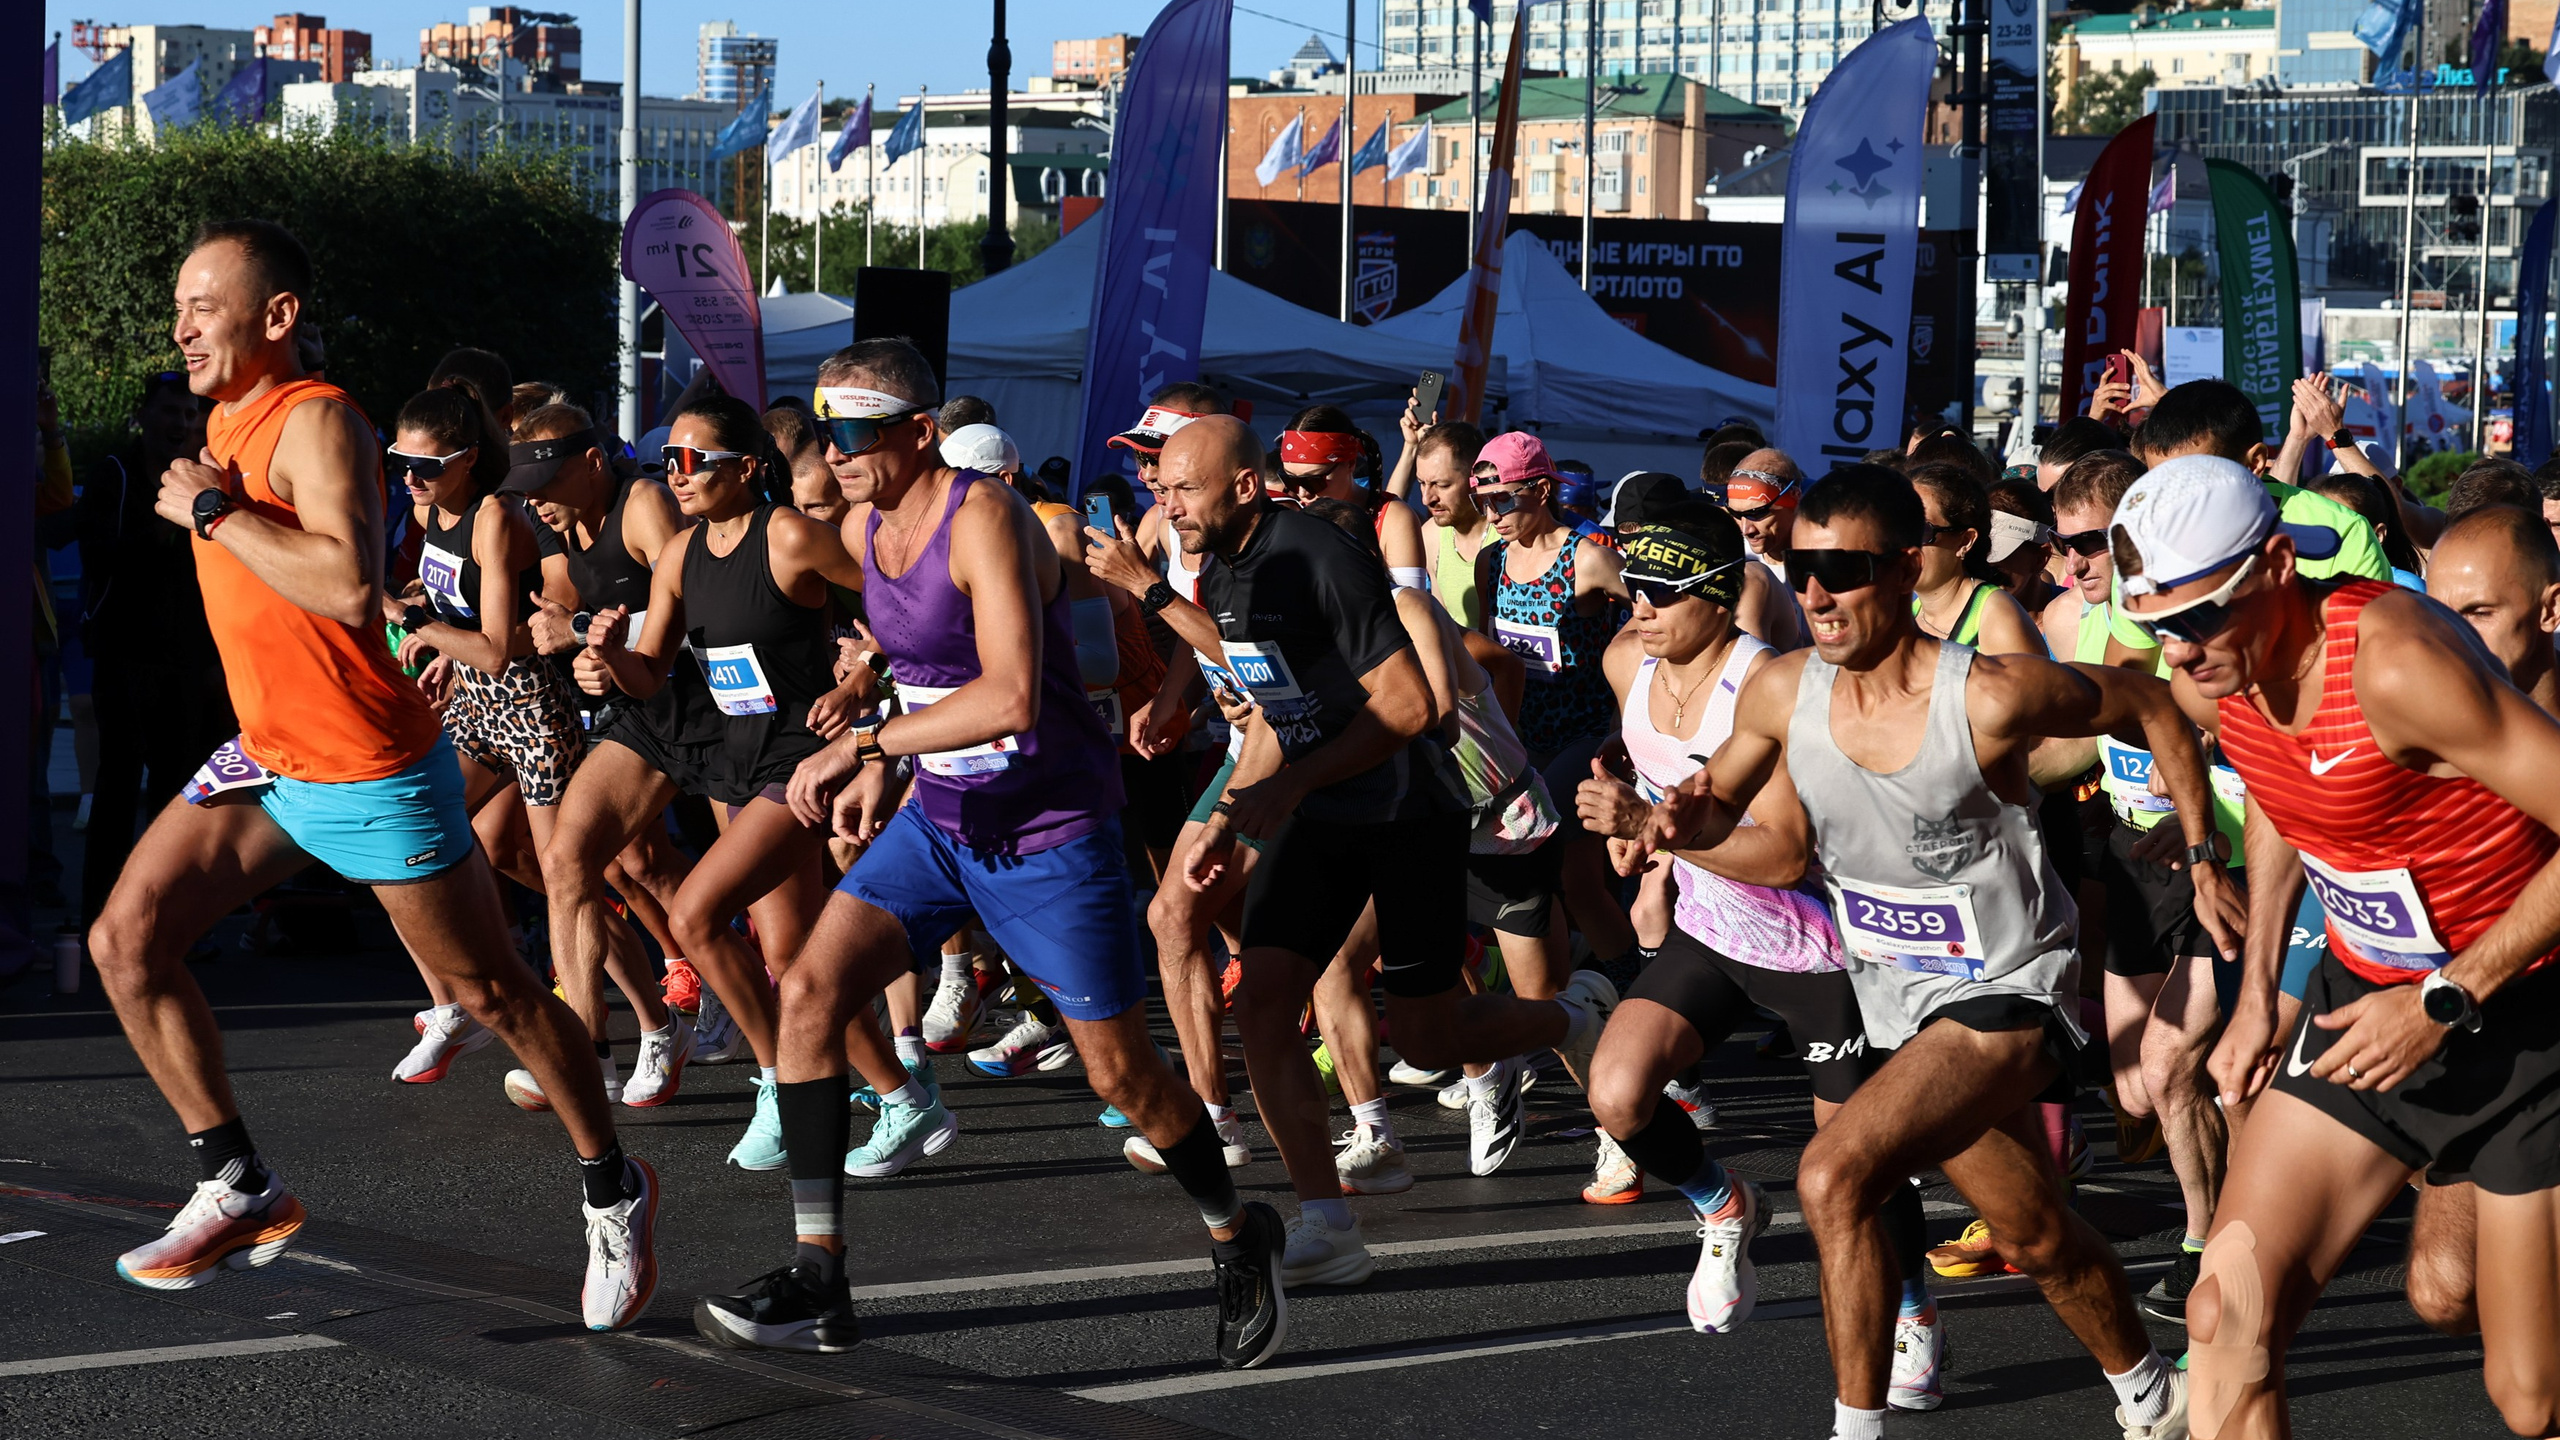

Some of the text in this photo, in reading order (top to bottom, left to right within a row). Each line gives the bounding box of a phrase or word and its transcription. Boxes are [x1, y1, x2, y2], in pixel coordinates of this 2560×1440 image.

[1997, 24, 2032, 37] 23-28
[1358, 247, 1395, 257] ИГРЫ
[1541, 239, 1743, 267] ДНЫЕ ИГРЫ ГТО
[1360, 273, 1392, 299] ГТО
[1820, 232, 1894, 470] laxy AI
[2008, 525, 2030, 534] KIPRUN
[1648, 542, 1708, 575] БЕГИ
[427, 563, 450, 589] 2177
[1507, 599, 1528, 607] UNDER
[1500, 635, 1546, 657] 2324
[1238, 662, 1276, 682] 1201
[766, 696, 774, 704] A
[968, 757, 1009, 771] 28km
[2314, 876, 2397, 930] 2033
[1857, 900, 1946, 935] 2359
[1876, 937, 1943, 951] #GalaxyMarathon
[1951, 944, 1962, 954] A
[1920, 958, 1970, 975] 28km
